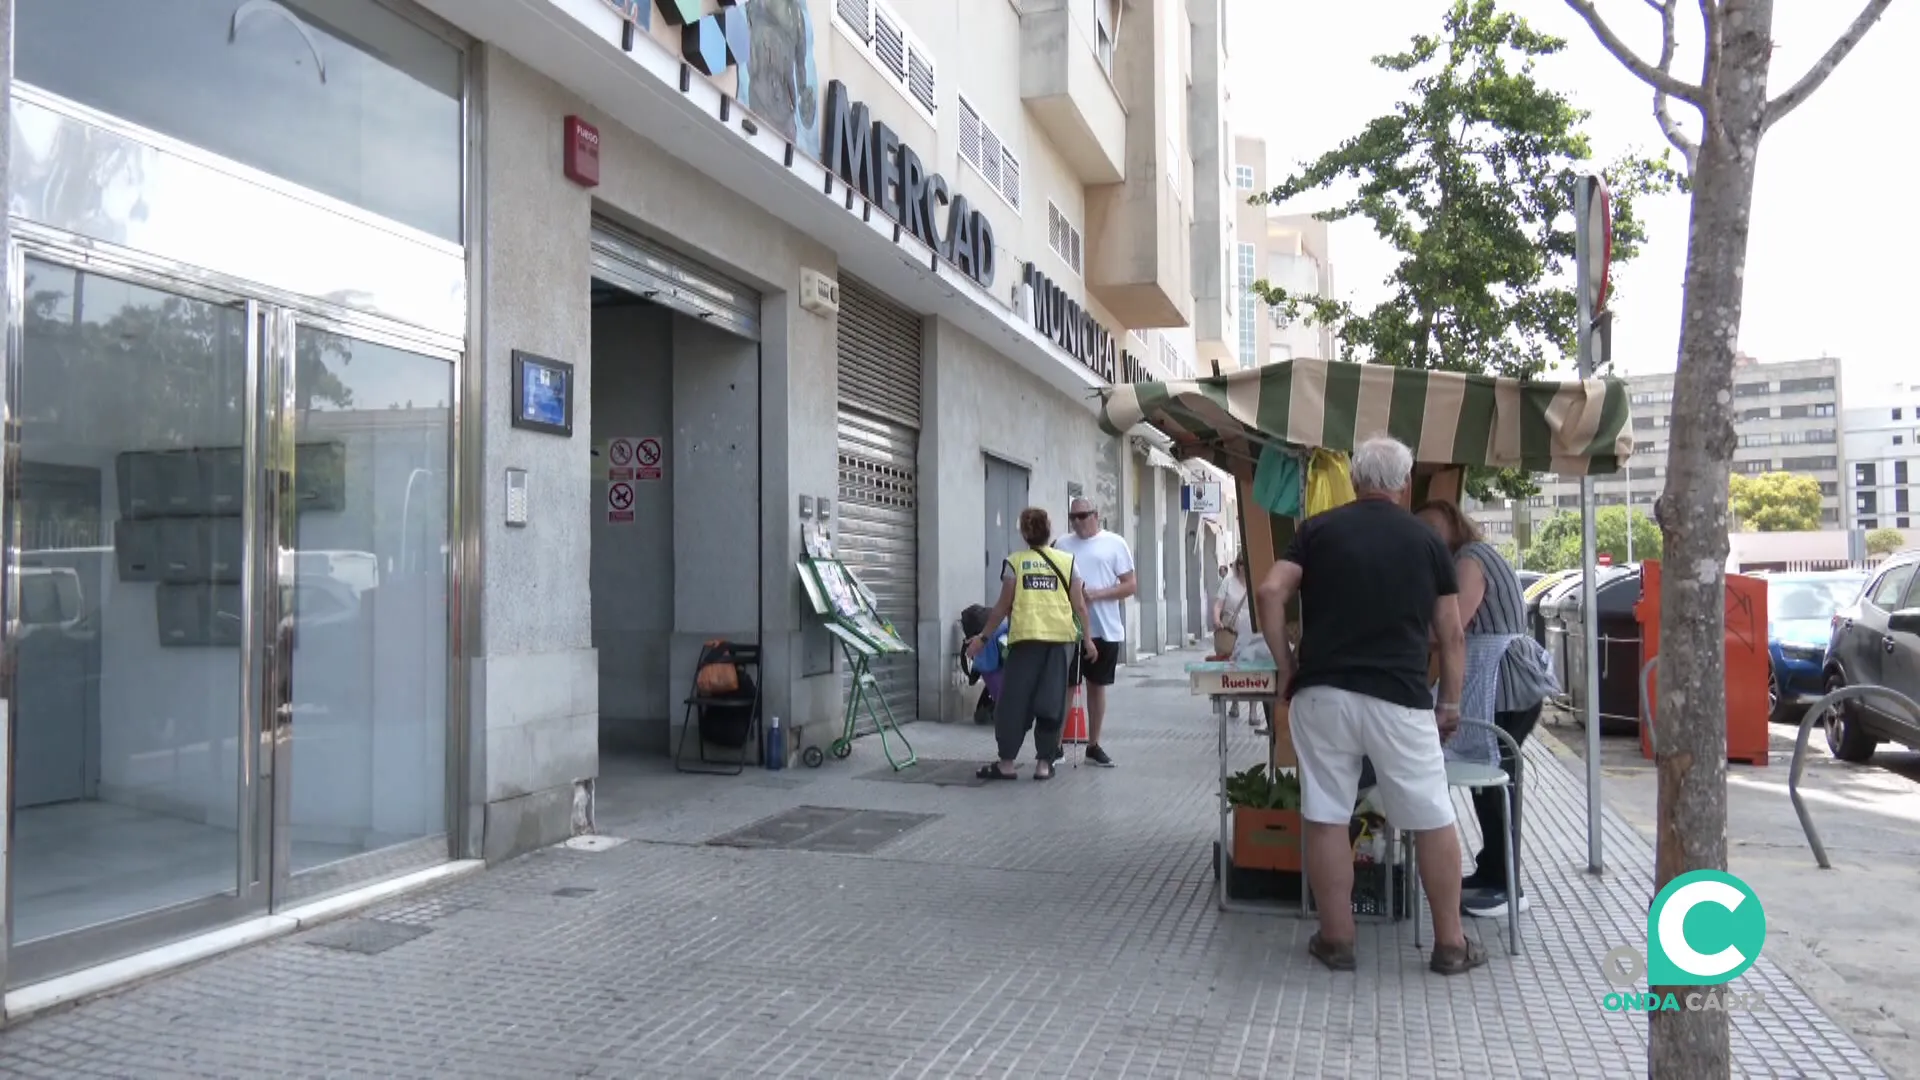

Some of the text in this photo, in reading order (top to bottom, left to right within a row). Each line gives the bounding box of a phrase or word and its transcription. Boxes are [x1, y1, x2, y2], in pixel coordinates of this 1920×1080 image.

[577, 124, 598, 145] FUEGO
[824, 79, 995, 288] MERCAD
[1023, 261, 1116, 384] MUNICIPA
